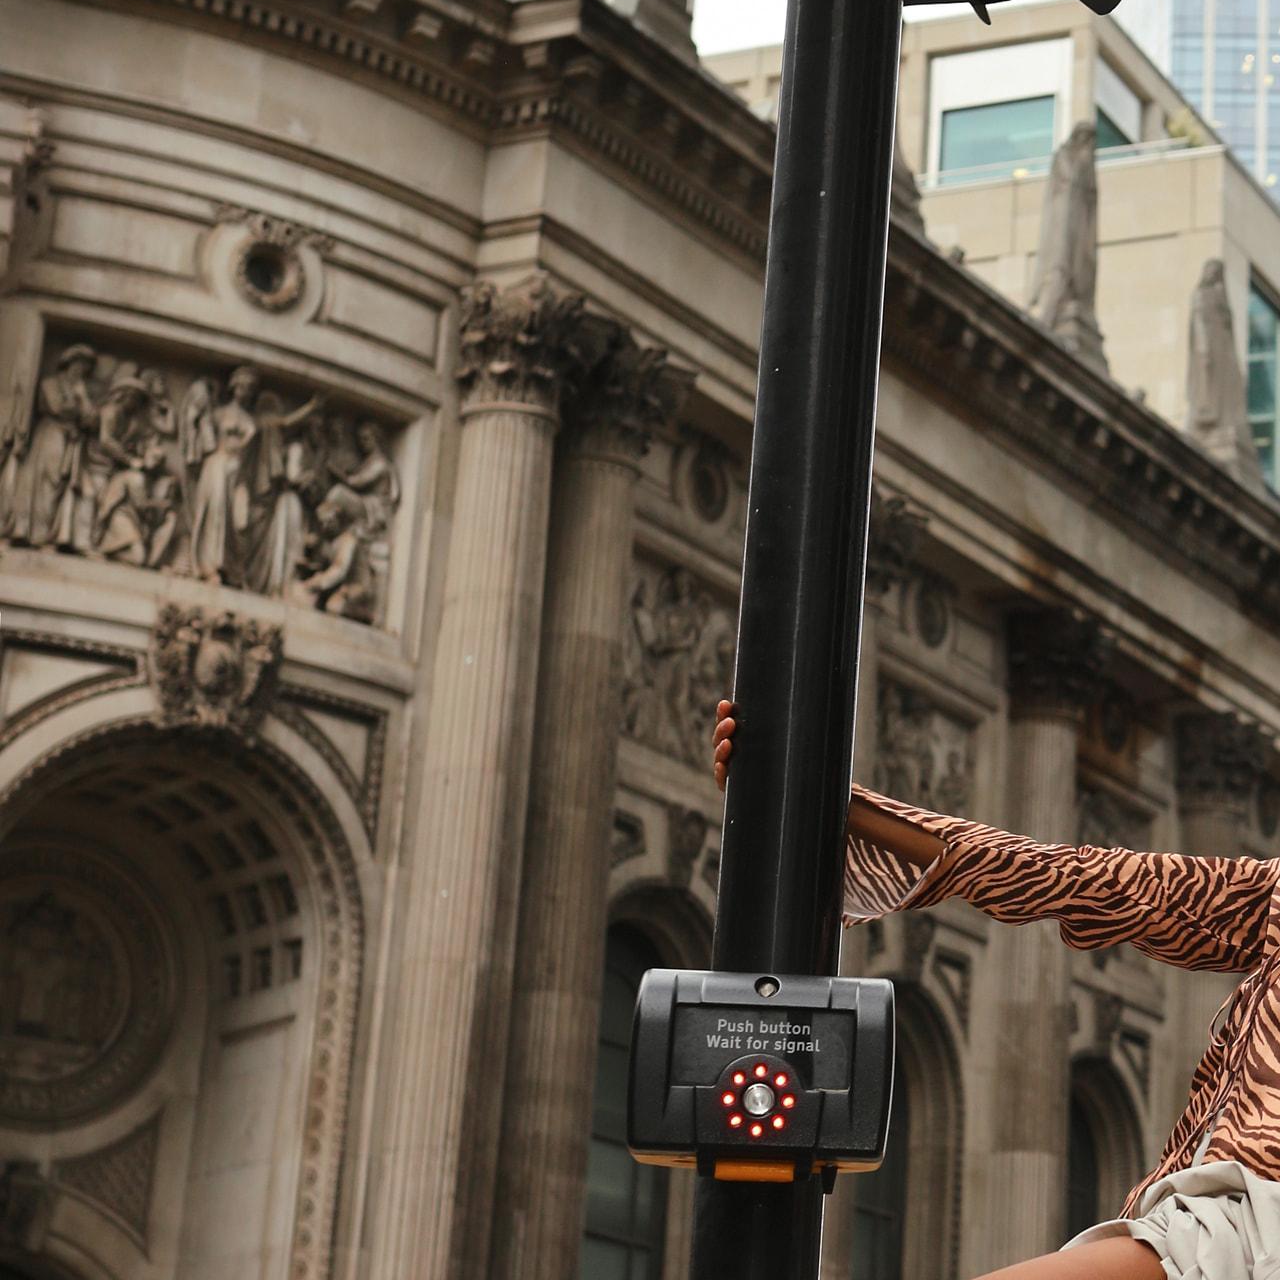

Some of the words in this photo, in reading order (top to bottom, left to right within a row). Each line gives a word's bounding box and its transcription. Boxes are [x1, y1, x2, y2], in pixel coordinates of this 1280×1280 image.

[717, 1018, 754, 1033] Push
[759, 1020, 811, 1035] button
[706, 1034, 741, 1049] Wait
[746, 1036, 769, 1050] for
[773, 1037, 821, 1054] signal
